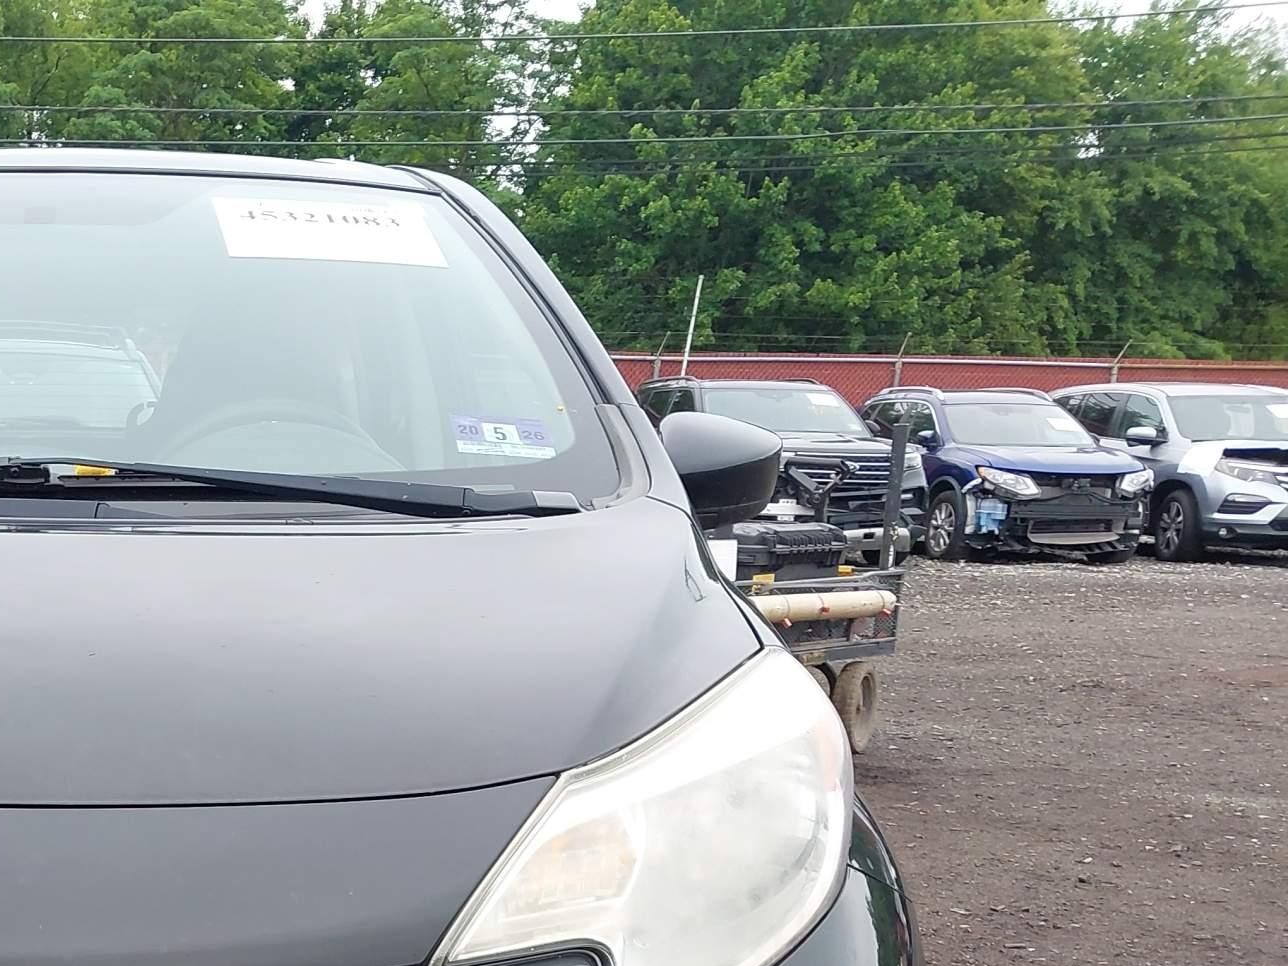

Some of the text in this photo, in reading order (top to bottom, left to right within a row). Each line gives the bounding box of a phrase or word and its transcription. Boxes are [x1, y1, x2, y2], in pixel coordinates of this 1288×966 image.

[457, 424, 545, 441] 20 5 26
